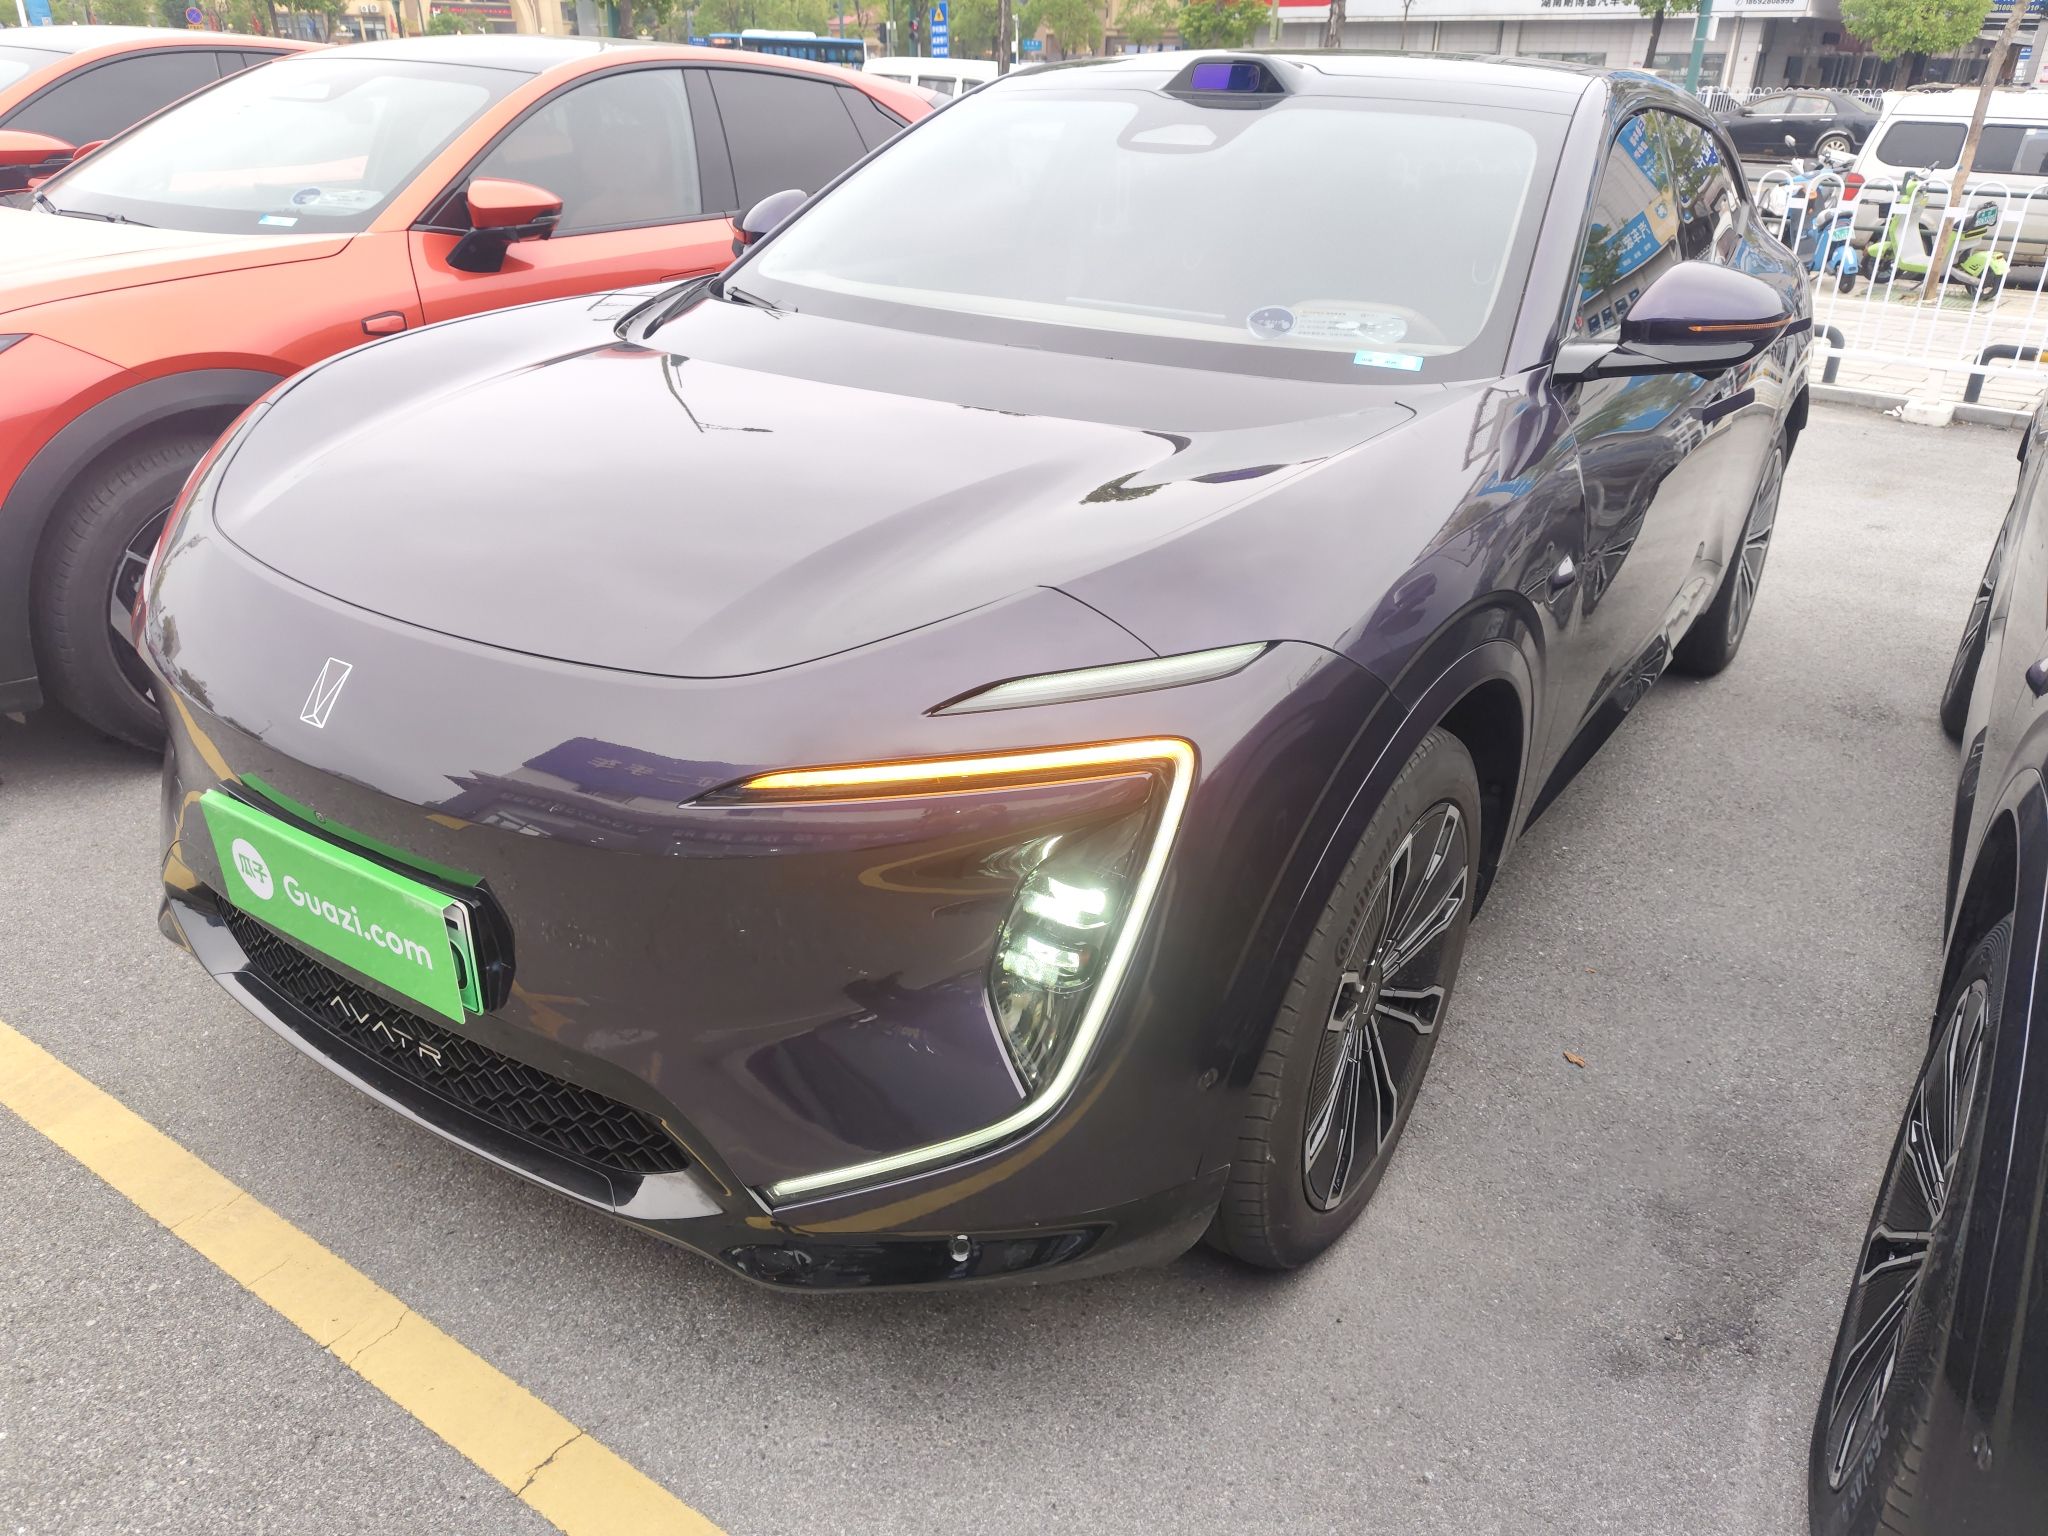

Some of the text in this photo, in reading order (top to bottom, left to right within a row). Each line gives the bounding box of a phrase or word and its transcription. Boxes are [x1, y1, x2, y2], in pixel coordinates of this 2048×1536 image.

[238, 853, 268, 884] 瓜子
[283, 875, 433, 970] Guazi.com
[330, 995, 442, 1068] AVATR
